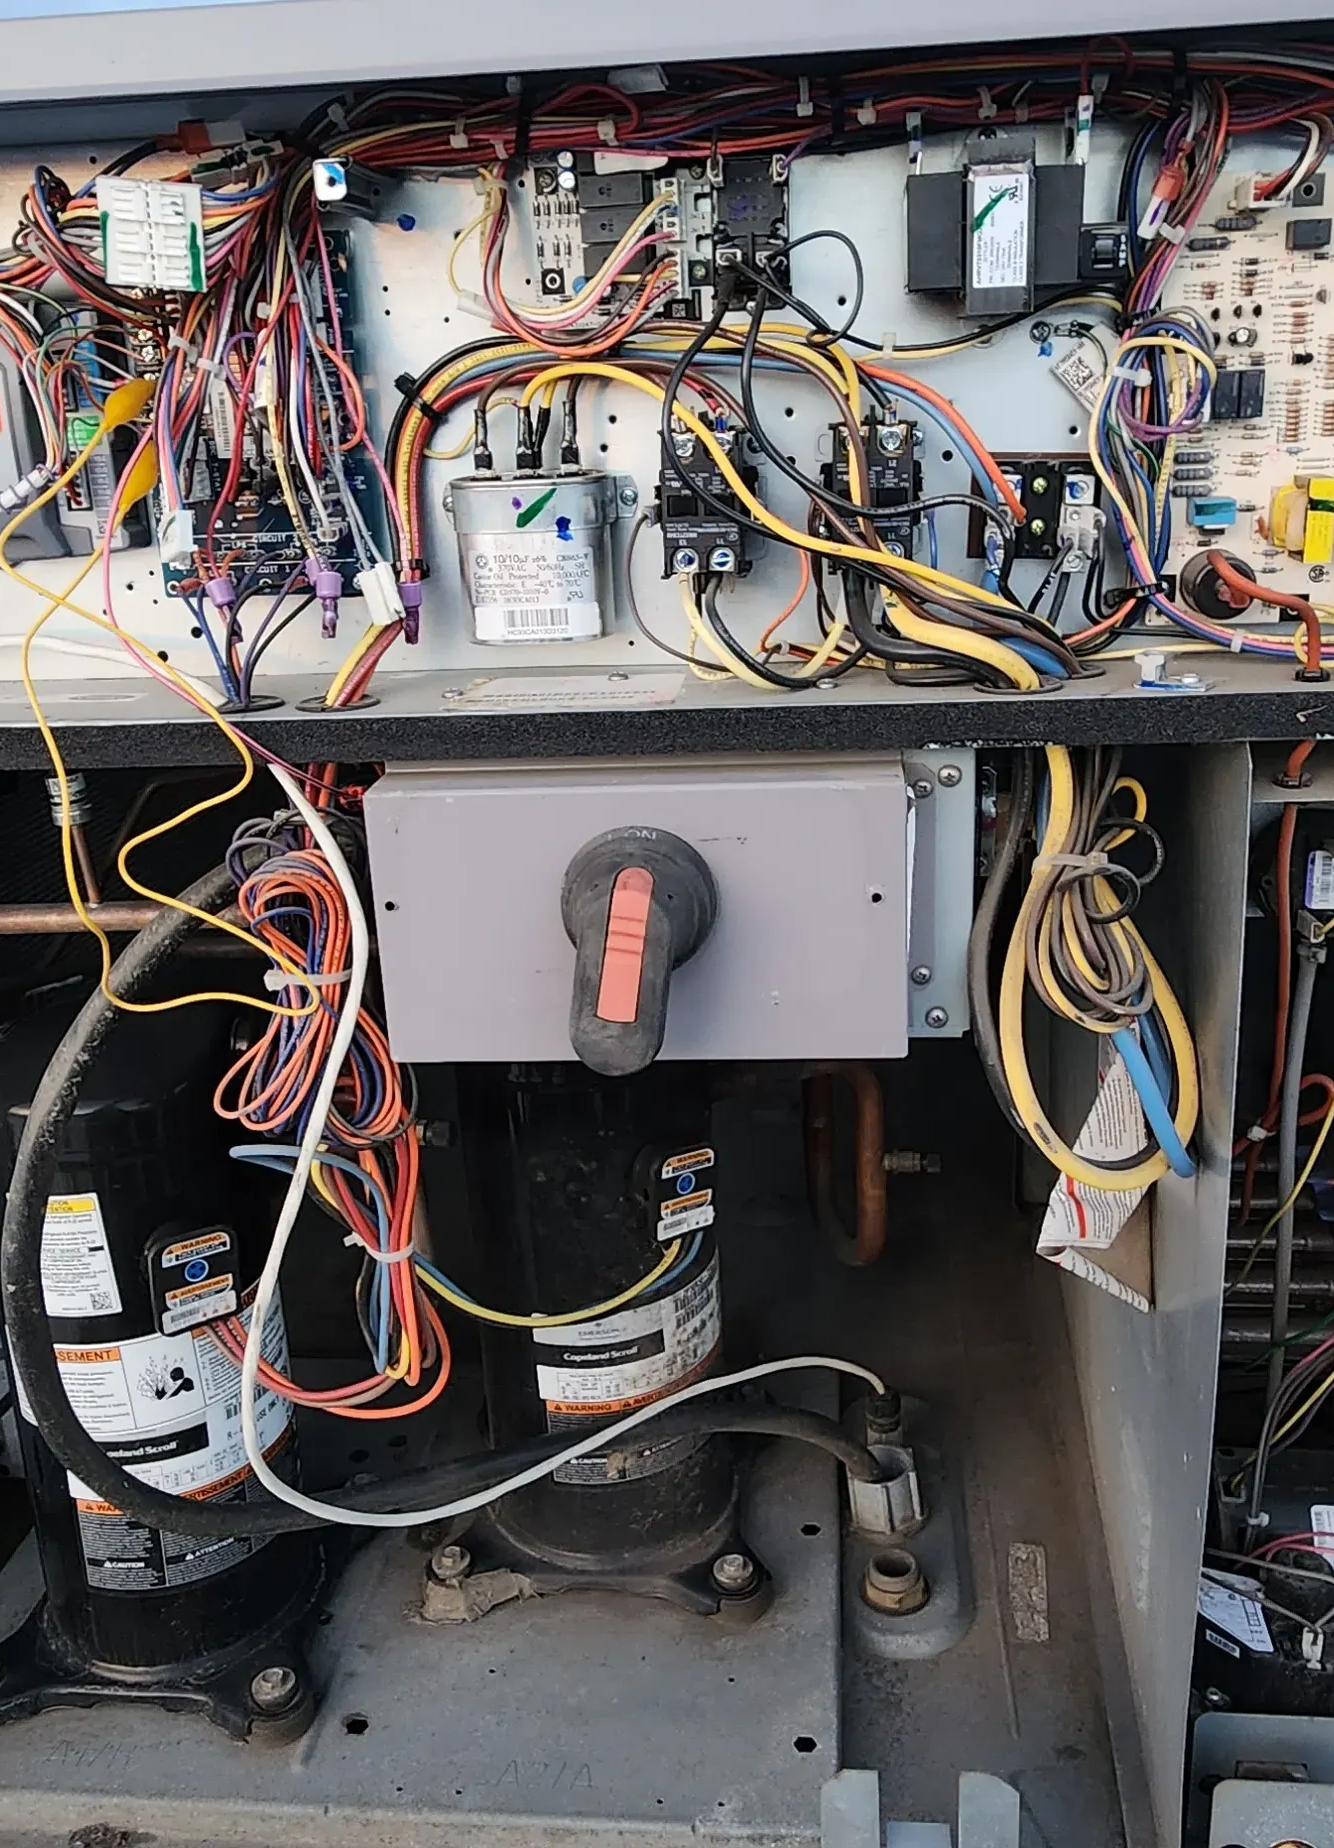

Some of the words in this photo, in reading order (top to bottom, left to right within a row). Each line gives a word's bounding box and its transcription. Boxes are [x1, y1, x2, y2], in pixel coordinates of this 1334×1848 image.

[55, 1350, 112, 1361] SEMENT
[563, 1352, 610, 1363] Copeland
[611, 1346, 639, 1358] Scroll
[565, 1404, 613, 1413] WARNING
[106, 1446, 144, 1459] peland
[145, 1439, 179, 1454] Scroll
